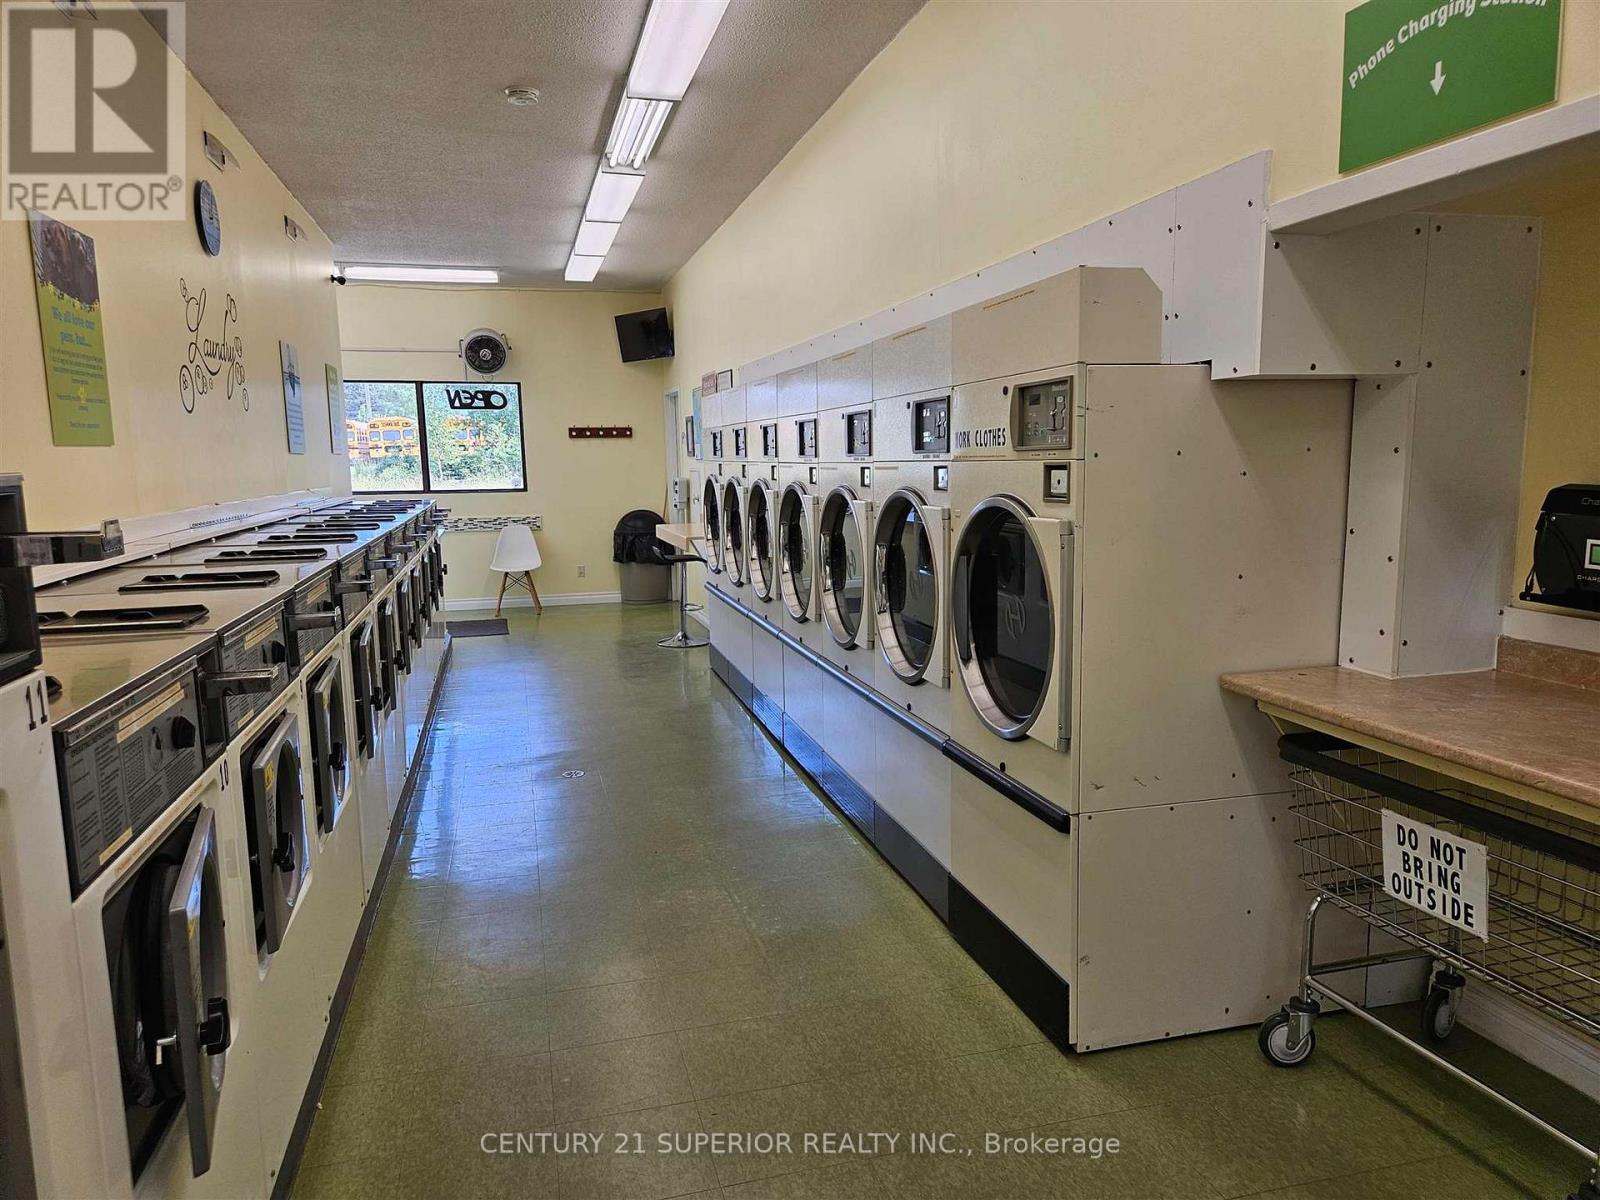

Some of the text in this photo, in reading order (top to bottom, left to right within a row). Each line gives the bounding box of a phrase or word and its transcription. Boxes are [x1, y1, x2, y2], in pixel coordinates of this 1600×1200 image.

[1348, 0, 1475, 89] Phone Charging
[185, 288, 238, 400] Laundry
[975, 428, 1006, 447] CLOTHES
[25, 680, 48, 731] 11
[219, 758, 229, 791] 10
[1397, 824, 1466, 870] DO NOT
[1402, 851, 1460, 895] BRING
[1392, 873, 1474, 928] OUTSIDE
